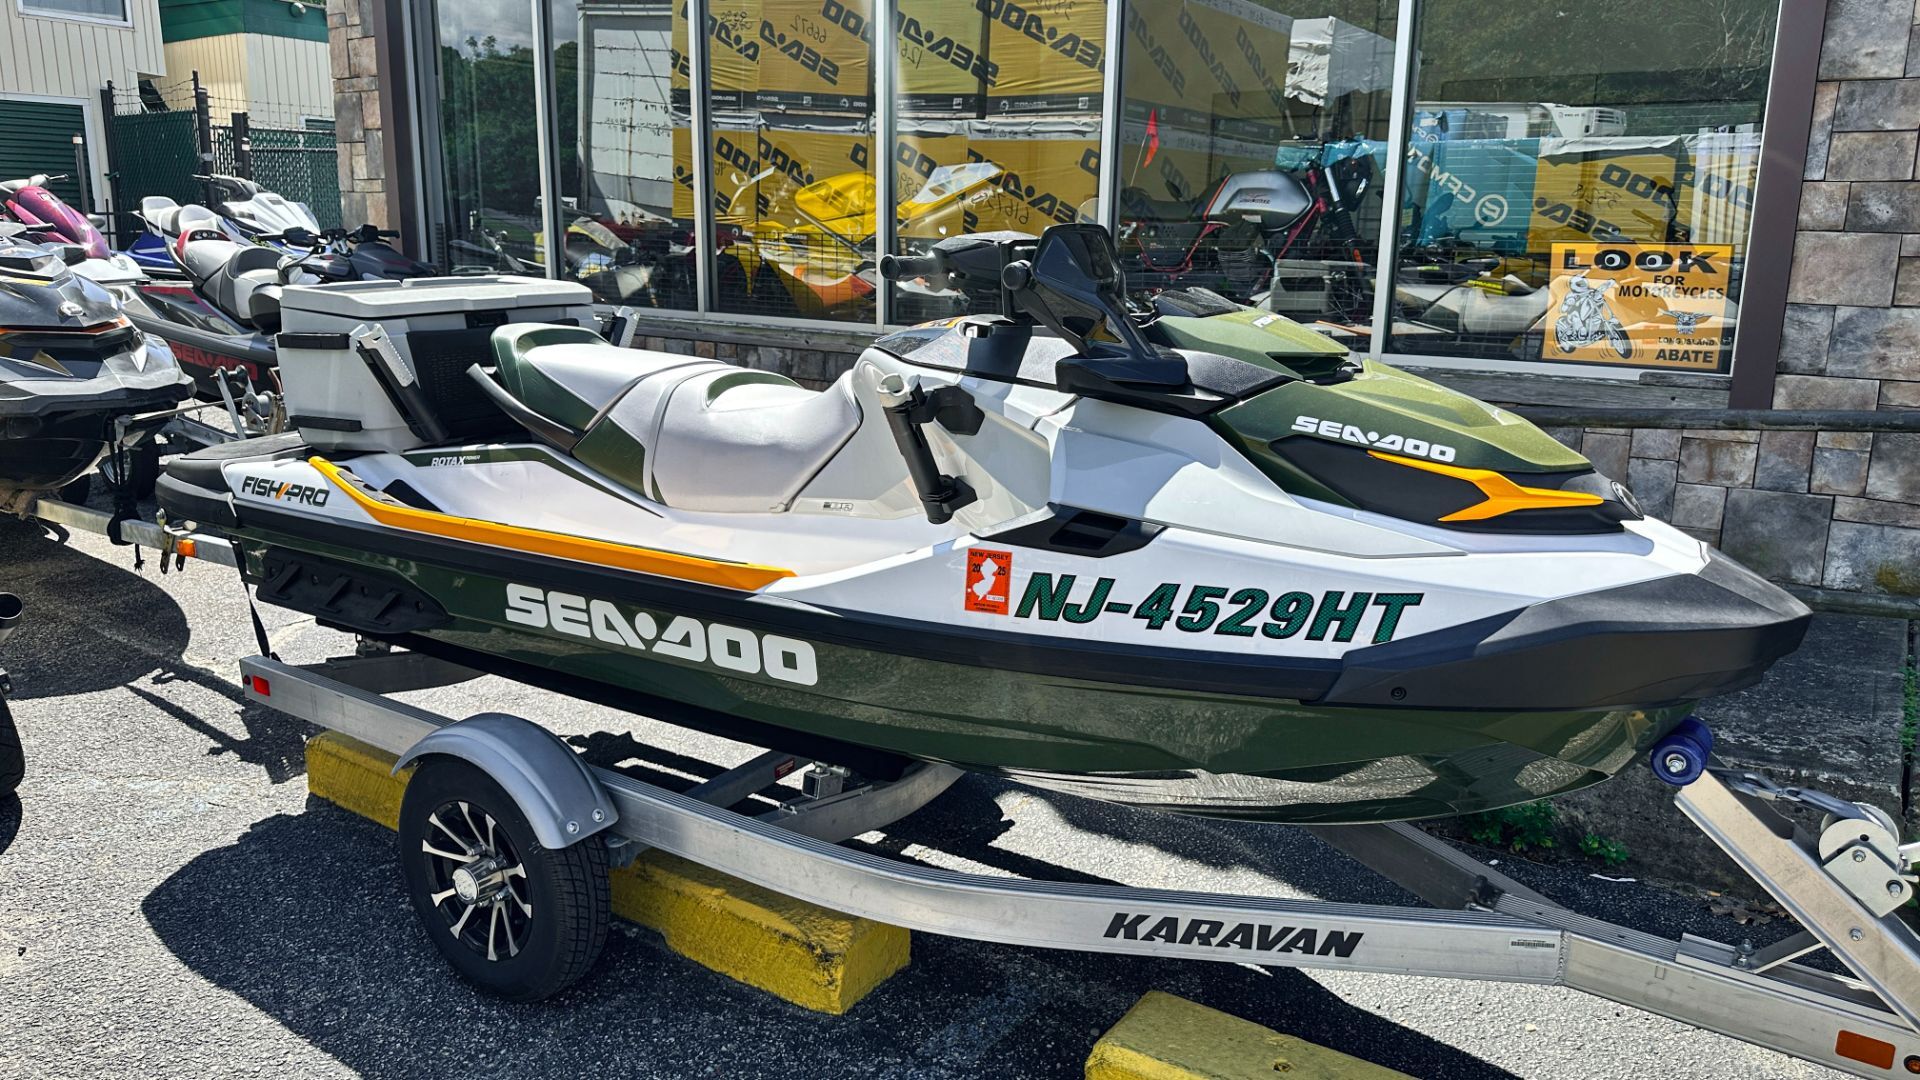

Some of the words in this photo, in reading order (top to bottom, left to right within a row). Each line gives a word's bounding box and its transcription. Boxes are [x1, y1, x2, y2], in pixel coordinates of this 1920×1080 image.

[1563, 248, 1720, 274] LOOK
[1653, 275, 1686, 286] FOR
[1618, 285, 1725, 300] MOTORCYCLES
[1655, 349, 1714, 364] ABATE
[431, 456, 465, 467] ROTAX
[985, 552, 1009, 561] JERSEY
[1014, 571, 1425, 645] NJ-4529HT
[1102, 912, 1365, 958] KARAVAN
